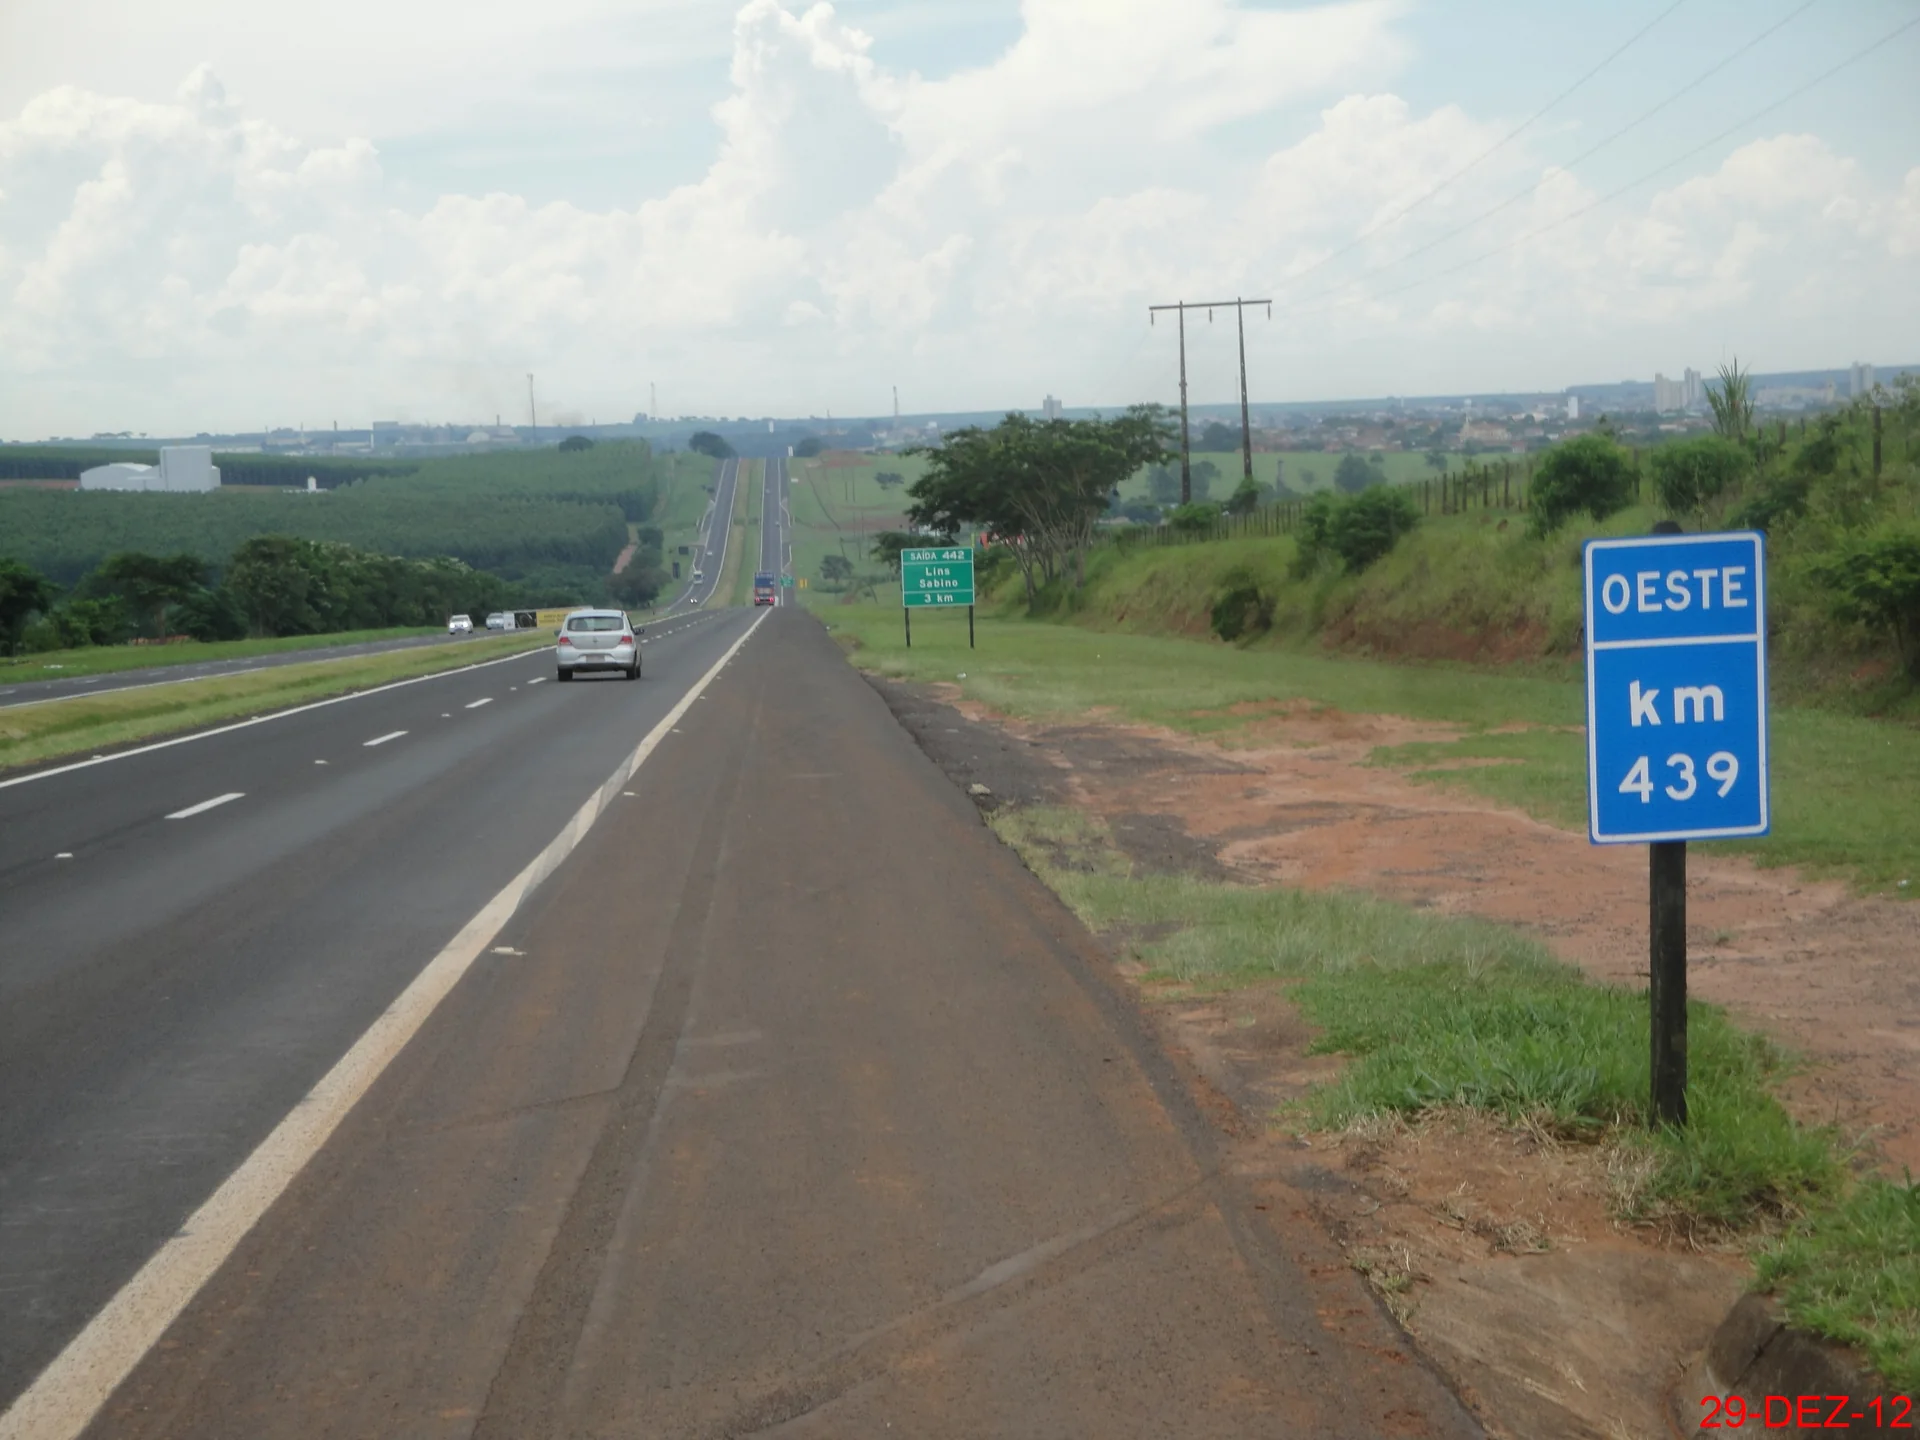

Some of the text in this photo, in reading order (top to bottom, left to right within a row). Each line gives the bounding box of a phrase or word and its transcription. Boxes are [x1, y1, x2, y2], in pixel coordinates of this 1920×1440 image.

[910, 550, 965, 560] SAÍDA 442
[925, 567, 950, 576] Lins
[919, 579, 958, 588] Sabino
[1602, 566, 1748, 614] OESTE
[924, 594, 953, 603] 3 km
[1629, 680, 1724, 727] km
[1618, 751, 1740, 804] 439
